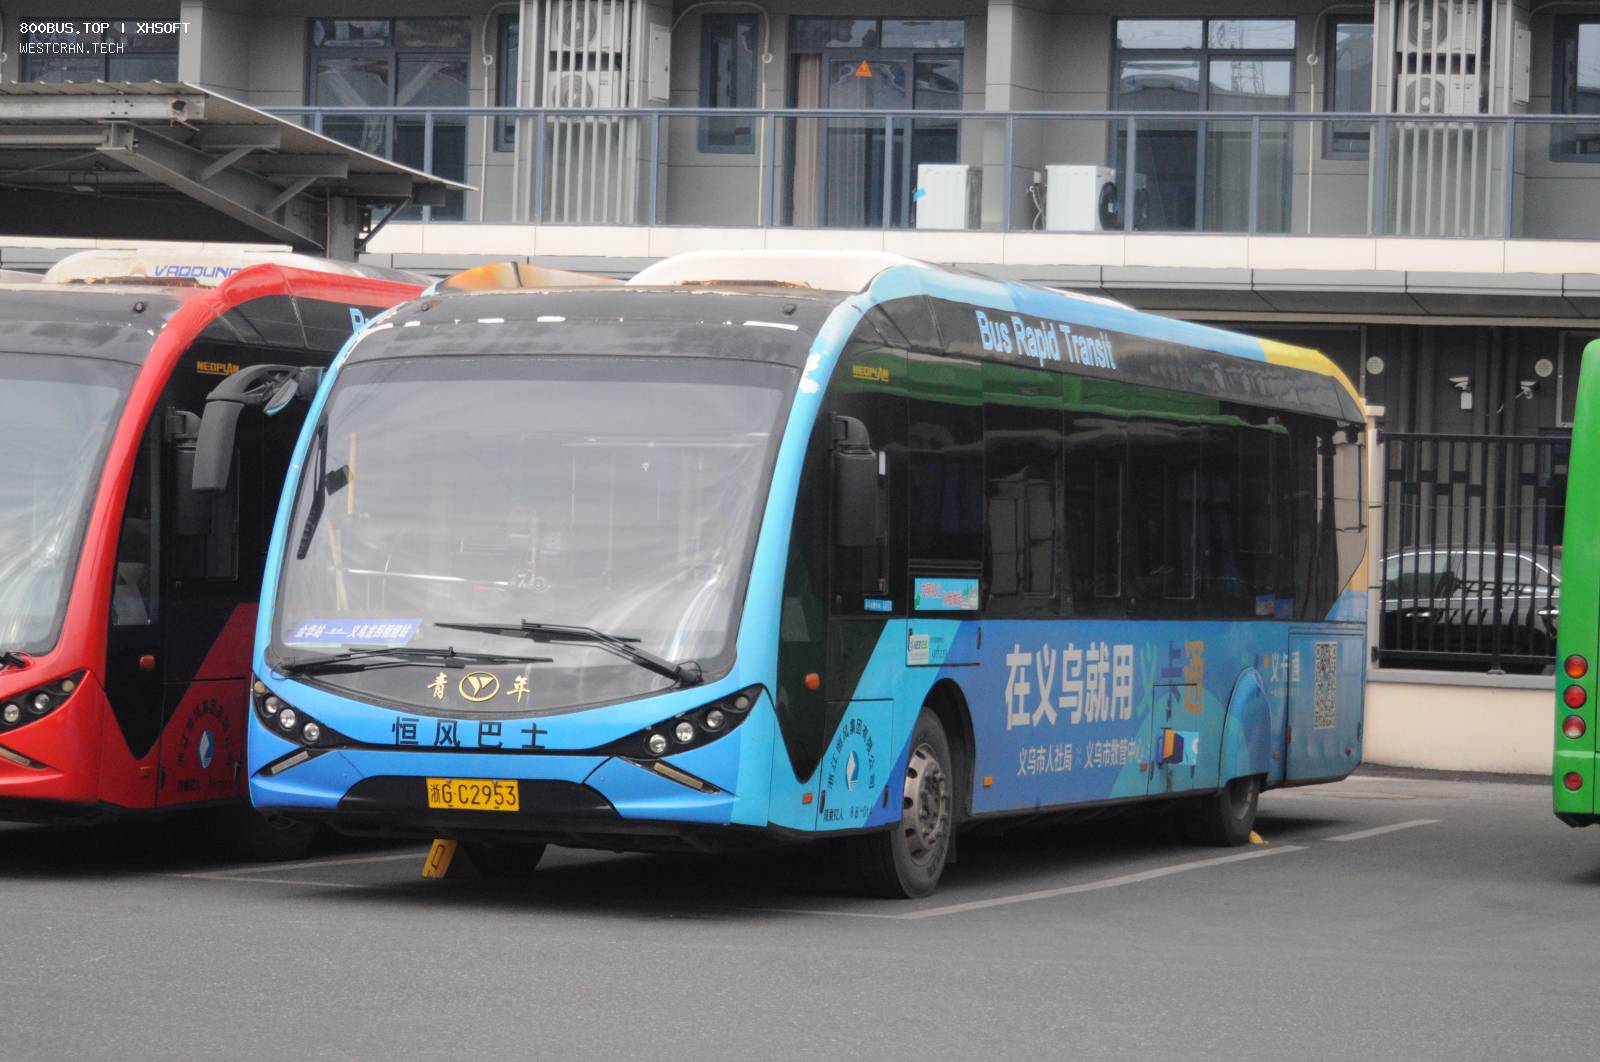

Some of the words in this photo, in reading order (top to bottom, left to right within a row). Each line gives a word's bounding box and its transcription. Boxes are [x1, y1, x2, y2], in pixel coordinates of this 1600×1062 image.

[975, 310, 1012, 353] Bus
[1011, 316, 1061, 367] Rapid
[1059, 324, 1117, 369] Transit
[392, 716, 548, 750] 恒风巴士
[1017, 744, 1073, 776] 义乌市人社局
